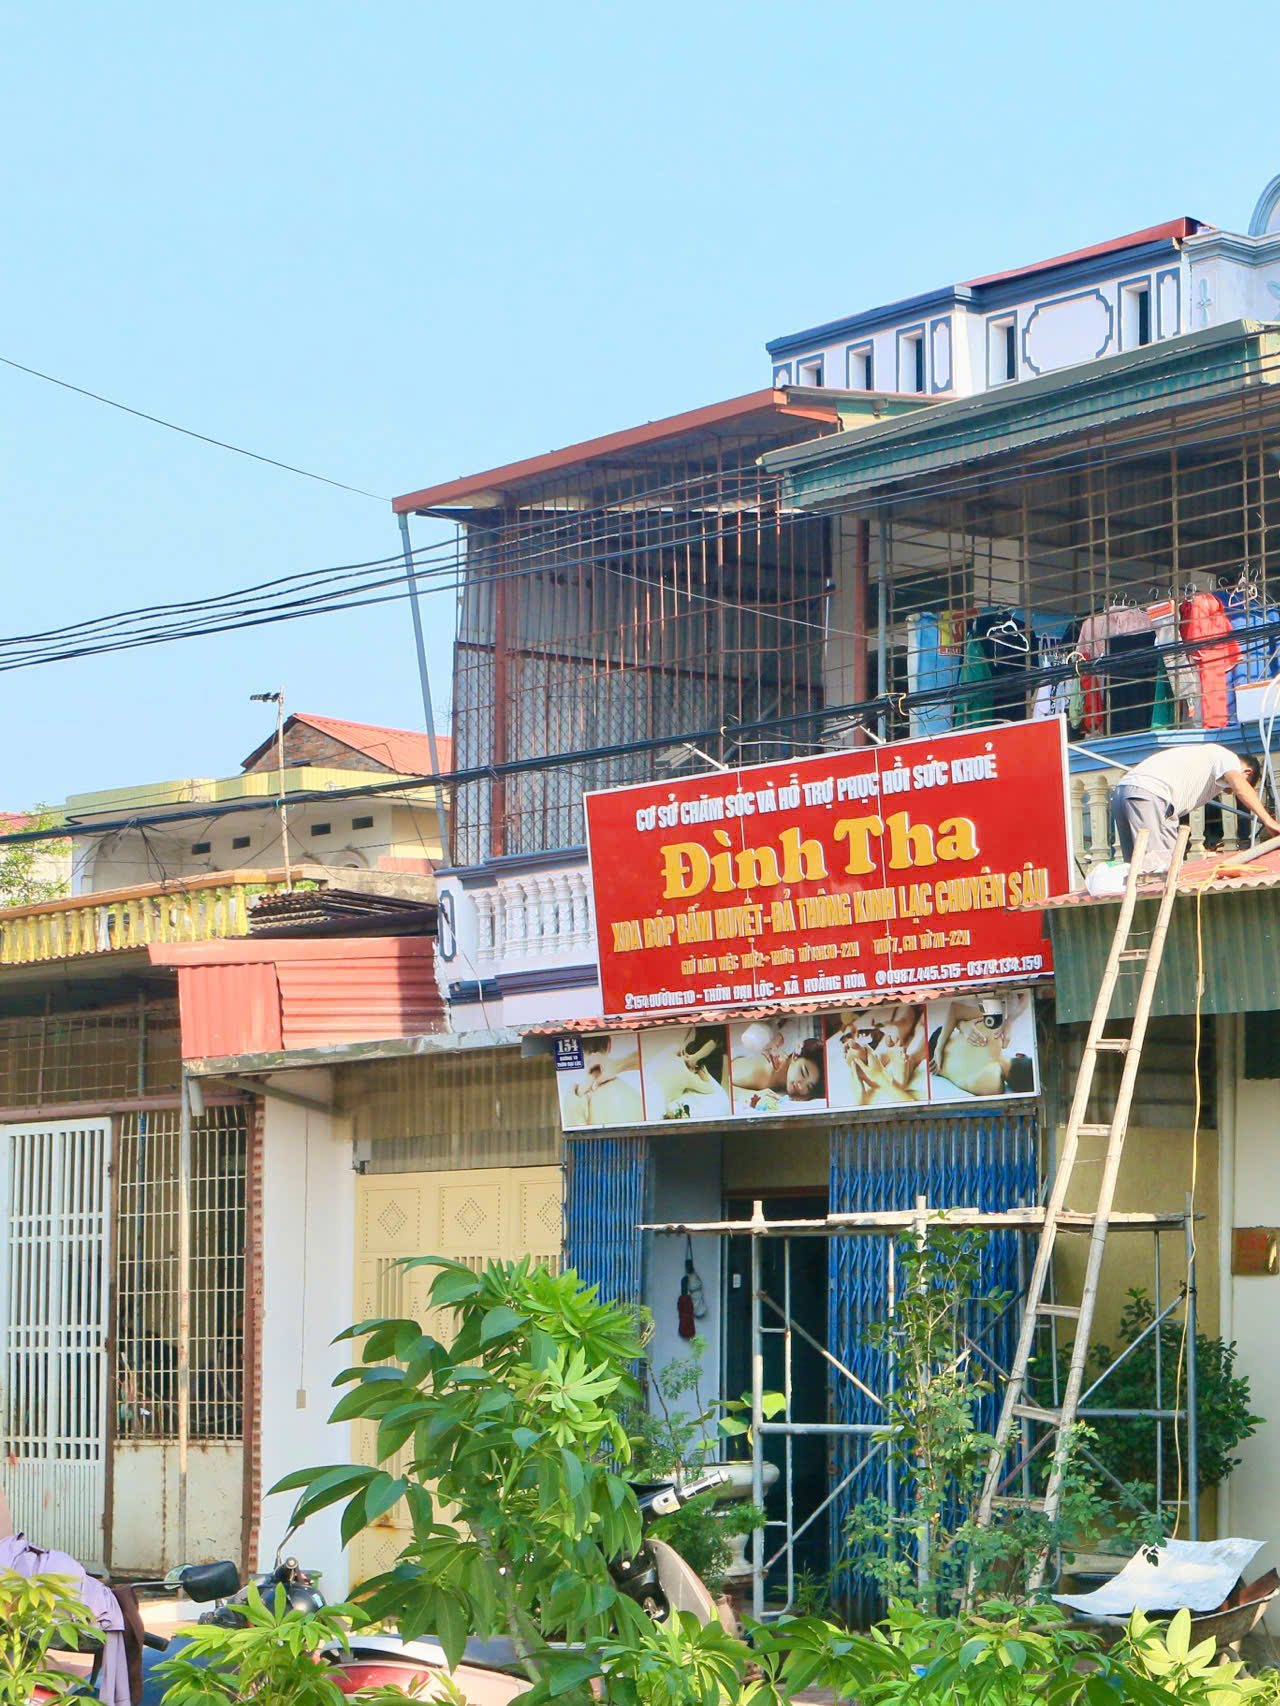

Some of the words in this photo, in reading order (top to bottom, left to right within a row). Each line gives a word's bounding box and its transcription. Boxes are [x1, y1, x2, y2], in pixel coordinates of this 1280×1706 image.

[639, 623, 666, 632] Panasonic
[636, 805, 656, 831] CƠ
[658, 793, 678, 828] SỞ
[680, 794, 724, 824] CHĂM
[725, 786, 755, 818] SÓC
[756, 781, 777, 813] VÀ
[778, 773, 800, 810] HỖ
[802, 776, 834, 809] TRỢ
[837, 772, 879, 804] PHỤC
[882, 756, 910, 794] HỒI
[913, 755, 949, 790] SỨC
[661, 827, 828, 900] Đình
[834, 812, 980, 875] Tha
[611, 920, 643, 952] XOA
[643, 909, 674, 948] BÓP
[676, 903, 713, 944] BẤM
[796, 888, 852, 929] THÔNG
[853, 887, 897, 923] KINH
[899, 882, 932, 924] LẠC
[935, 866, 1006, 914] CHUYÊN
[1008, 862, 1049, 907] SÂU
[703, 984, 731, 1002] THÔN
[733, 984, 752, 1001] ĐẠI
[754, 980, 775, 1000] LỘC
[784, 975, 799, 995] XÃ
[844, 970, 866, 989] HÓA
[558, 1038, 578, 1052] 154
